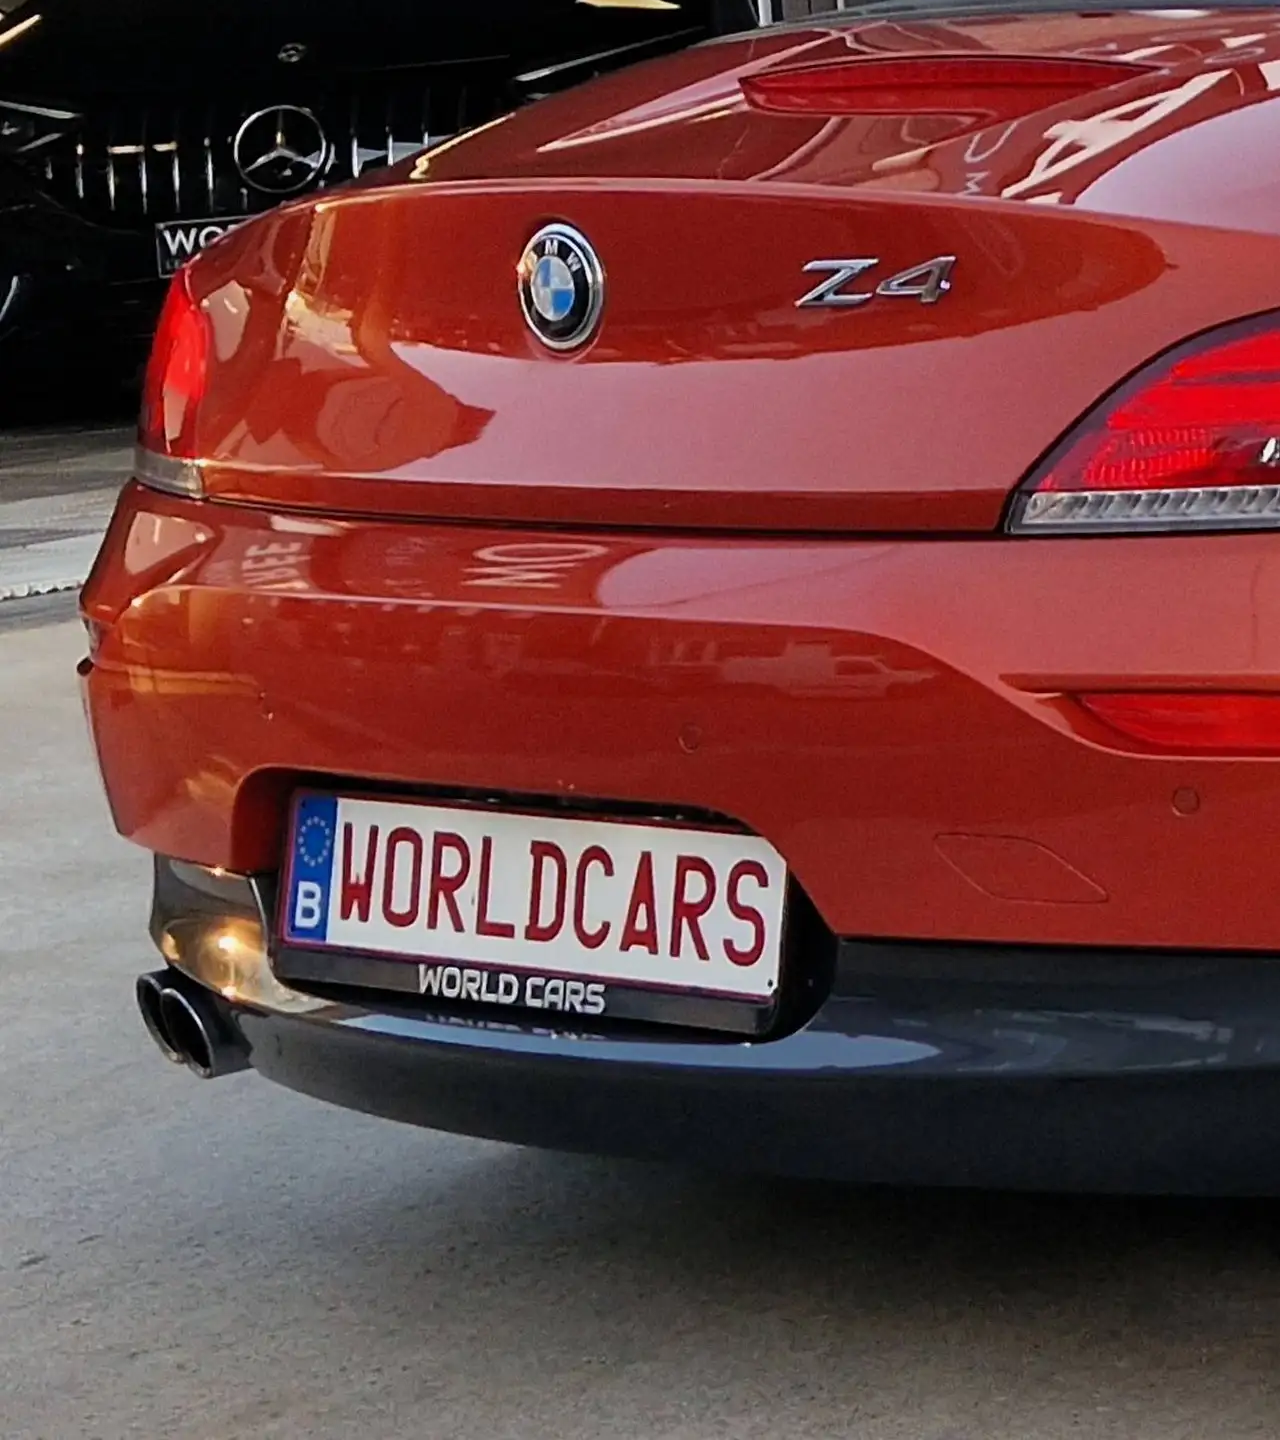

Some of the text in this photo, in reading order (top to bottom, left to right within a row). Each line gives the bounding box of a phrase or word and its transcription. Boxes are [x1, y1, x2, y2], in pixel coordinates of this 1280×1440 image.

[795, 256, 956, 308] Z4
[295, 882, 322, 928] B
[340, 822, 769, 967] WORLDCARS
[418, 964, 606, 1015] WORLD CARS
